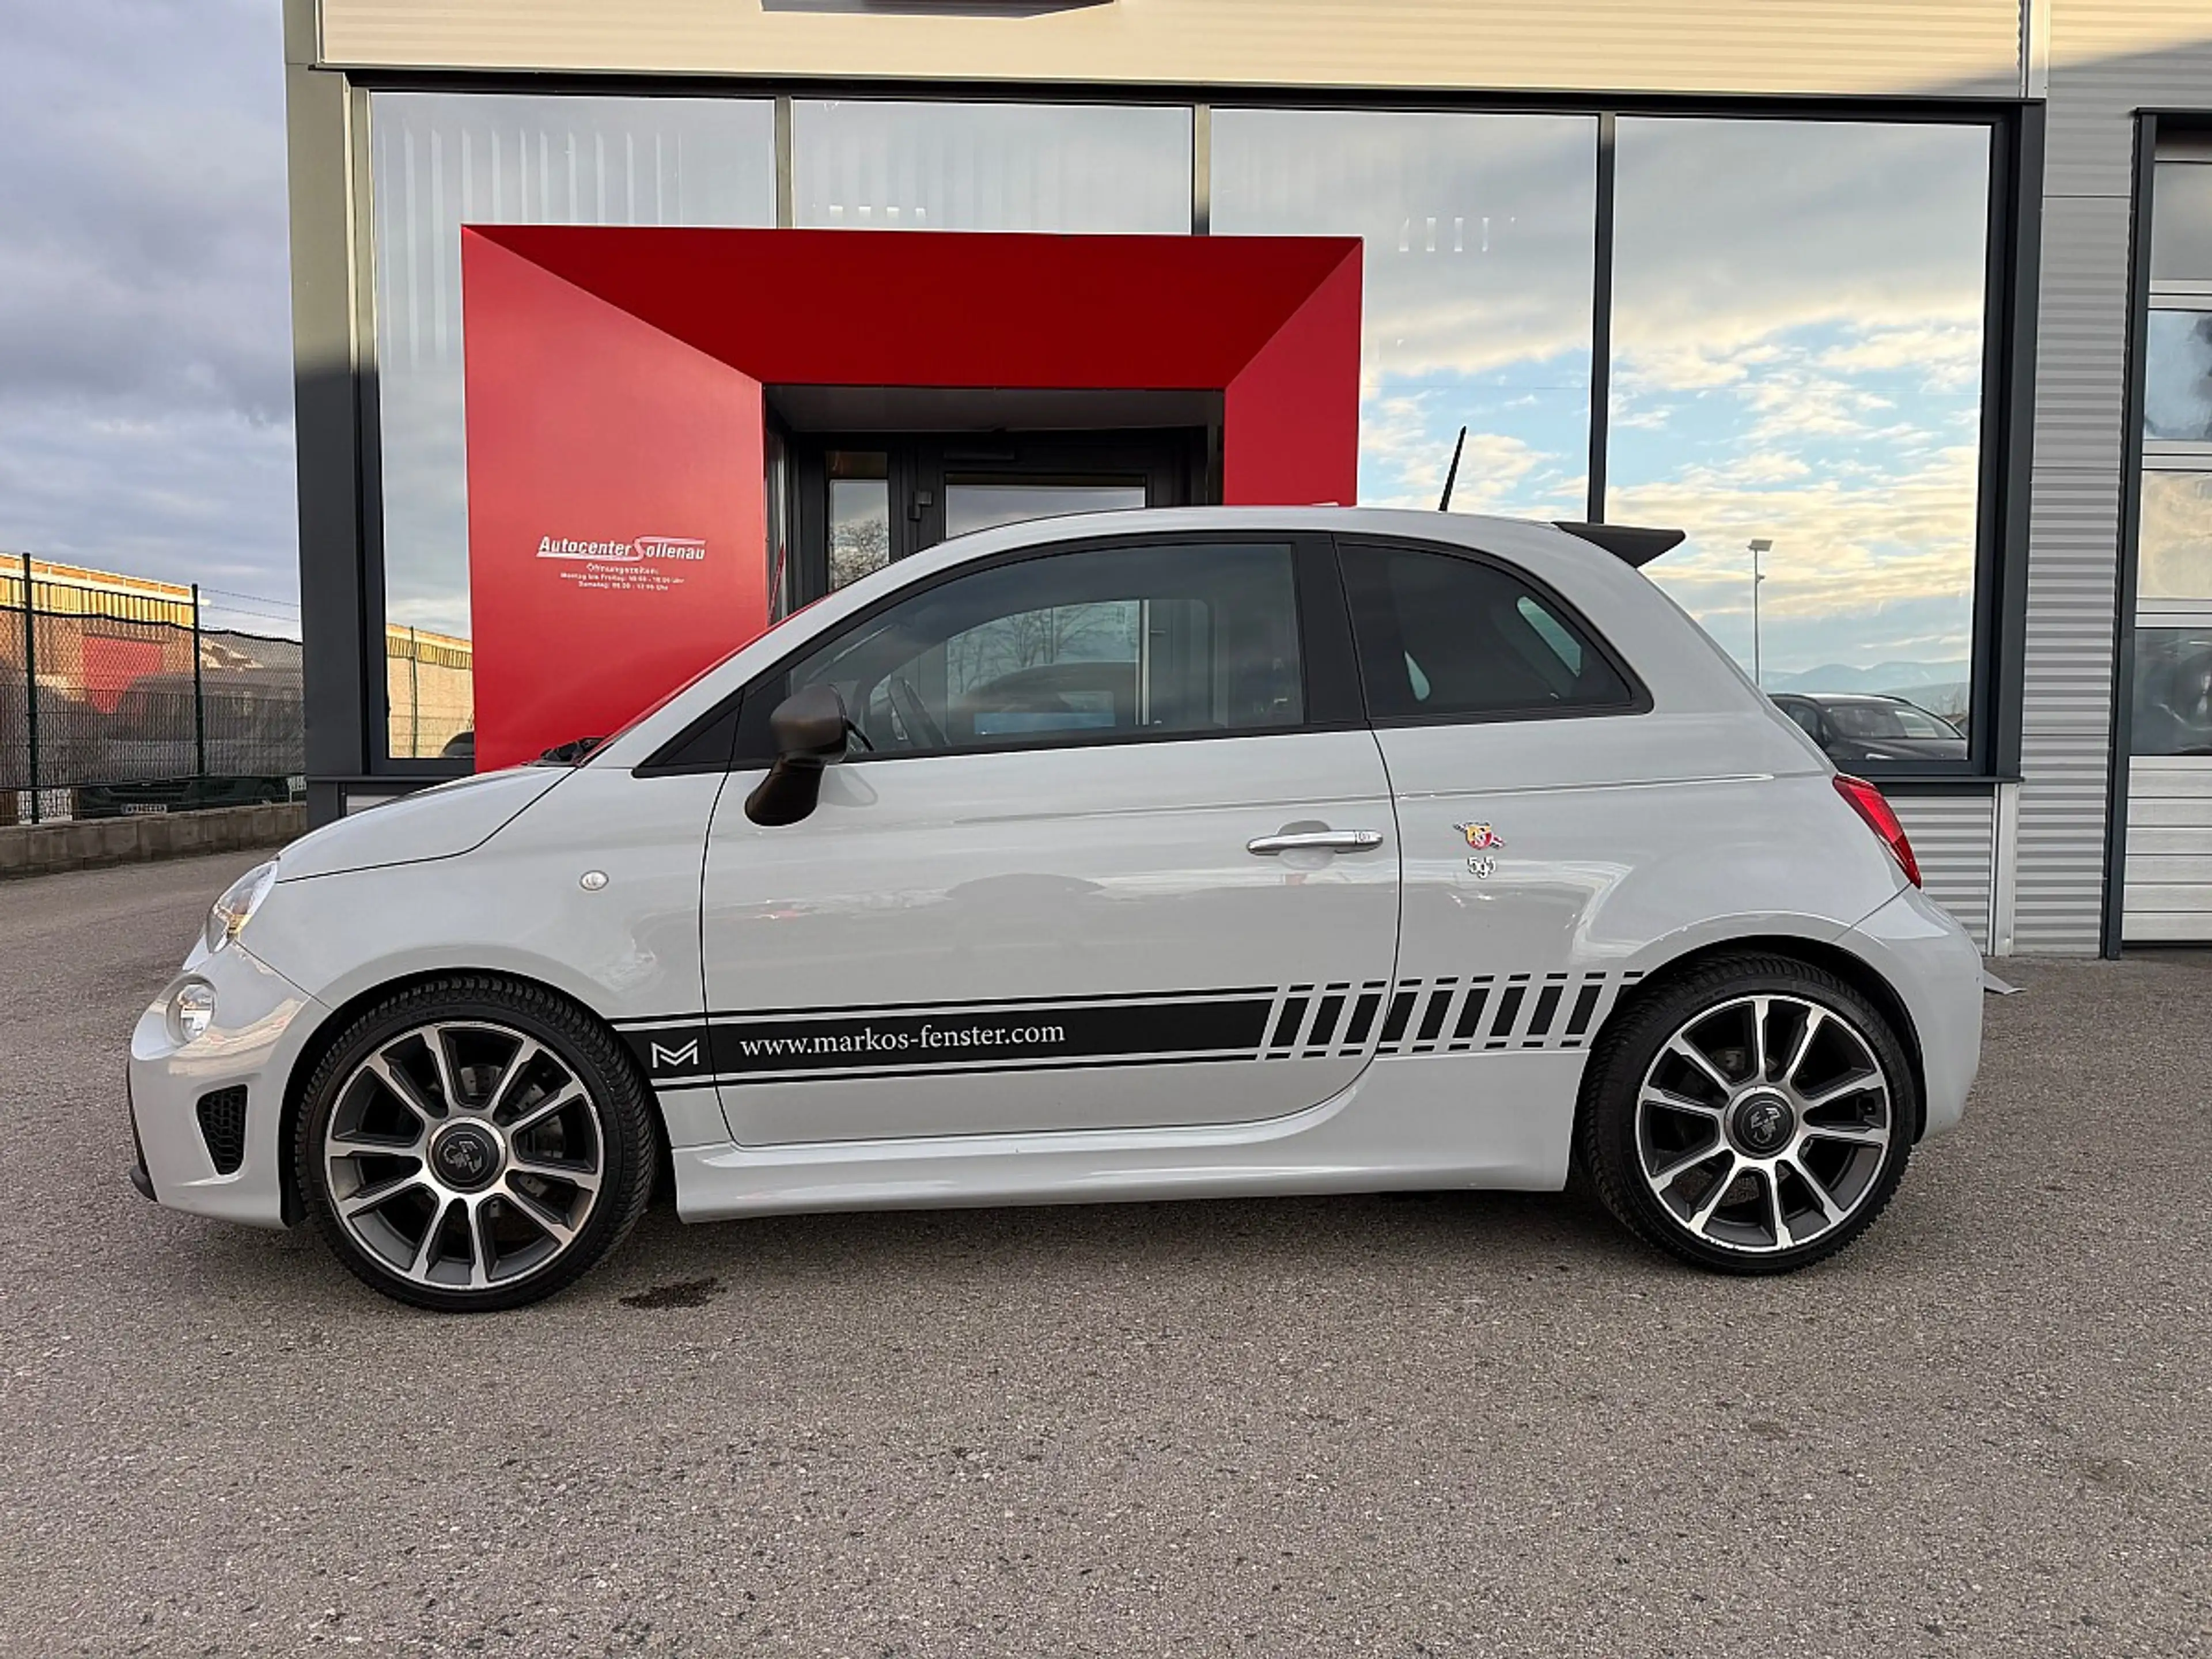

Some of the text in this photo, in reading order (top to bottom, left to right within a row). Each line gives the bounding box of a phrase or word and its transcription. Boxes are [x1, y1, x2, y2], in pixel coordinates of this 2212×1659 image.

[538, 535, 706, 560] Autocenter Sollenau
[1467, 855, 1497, 880] 595
[740, 1024, 1066, 1058] www.markos-fenster.com
